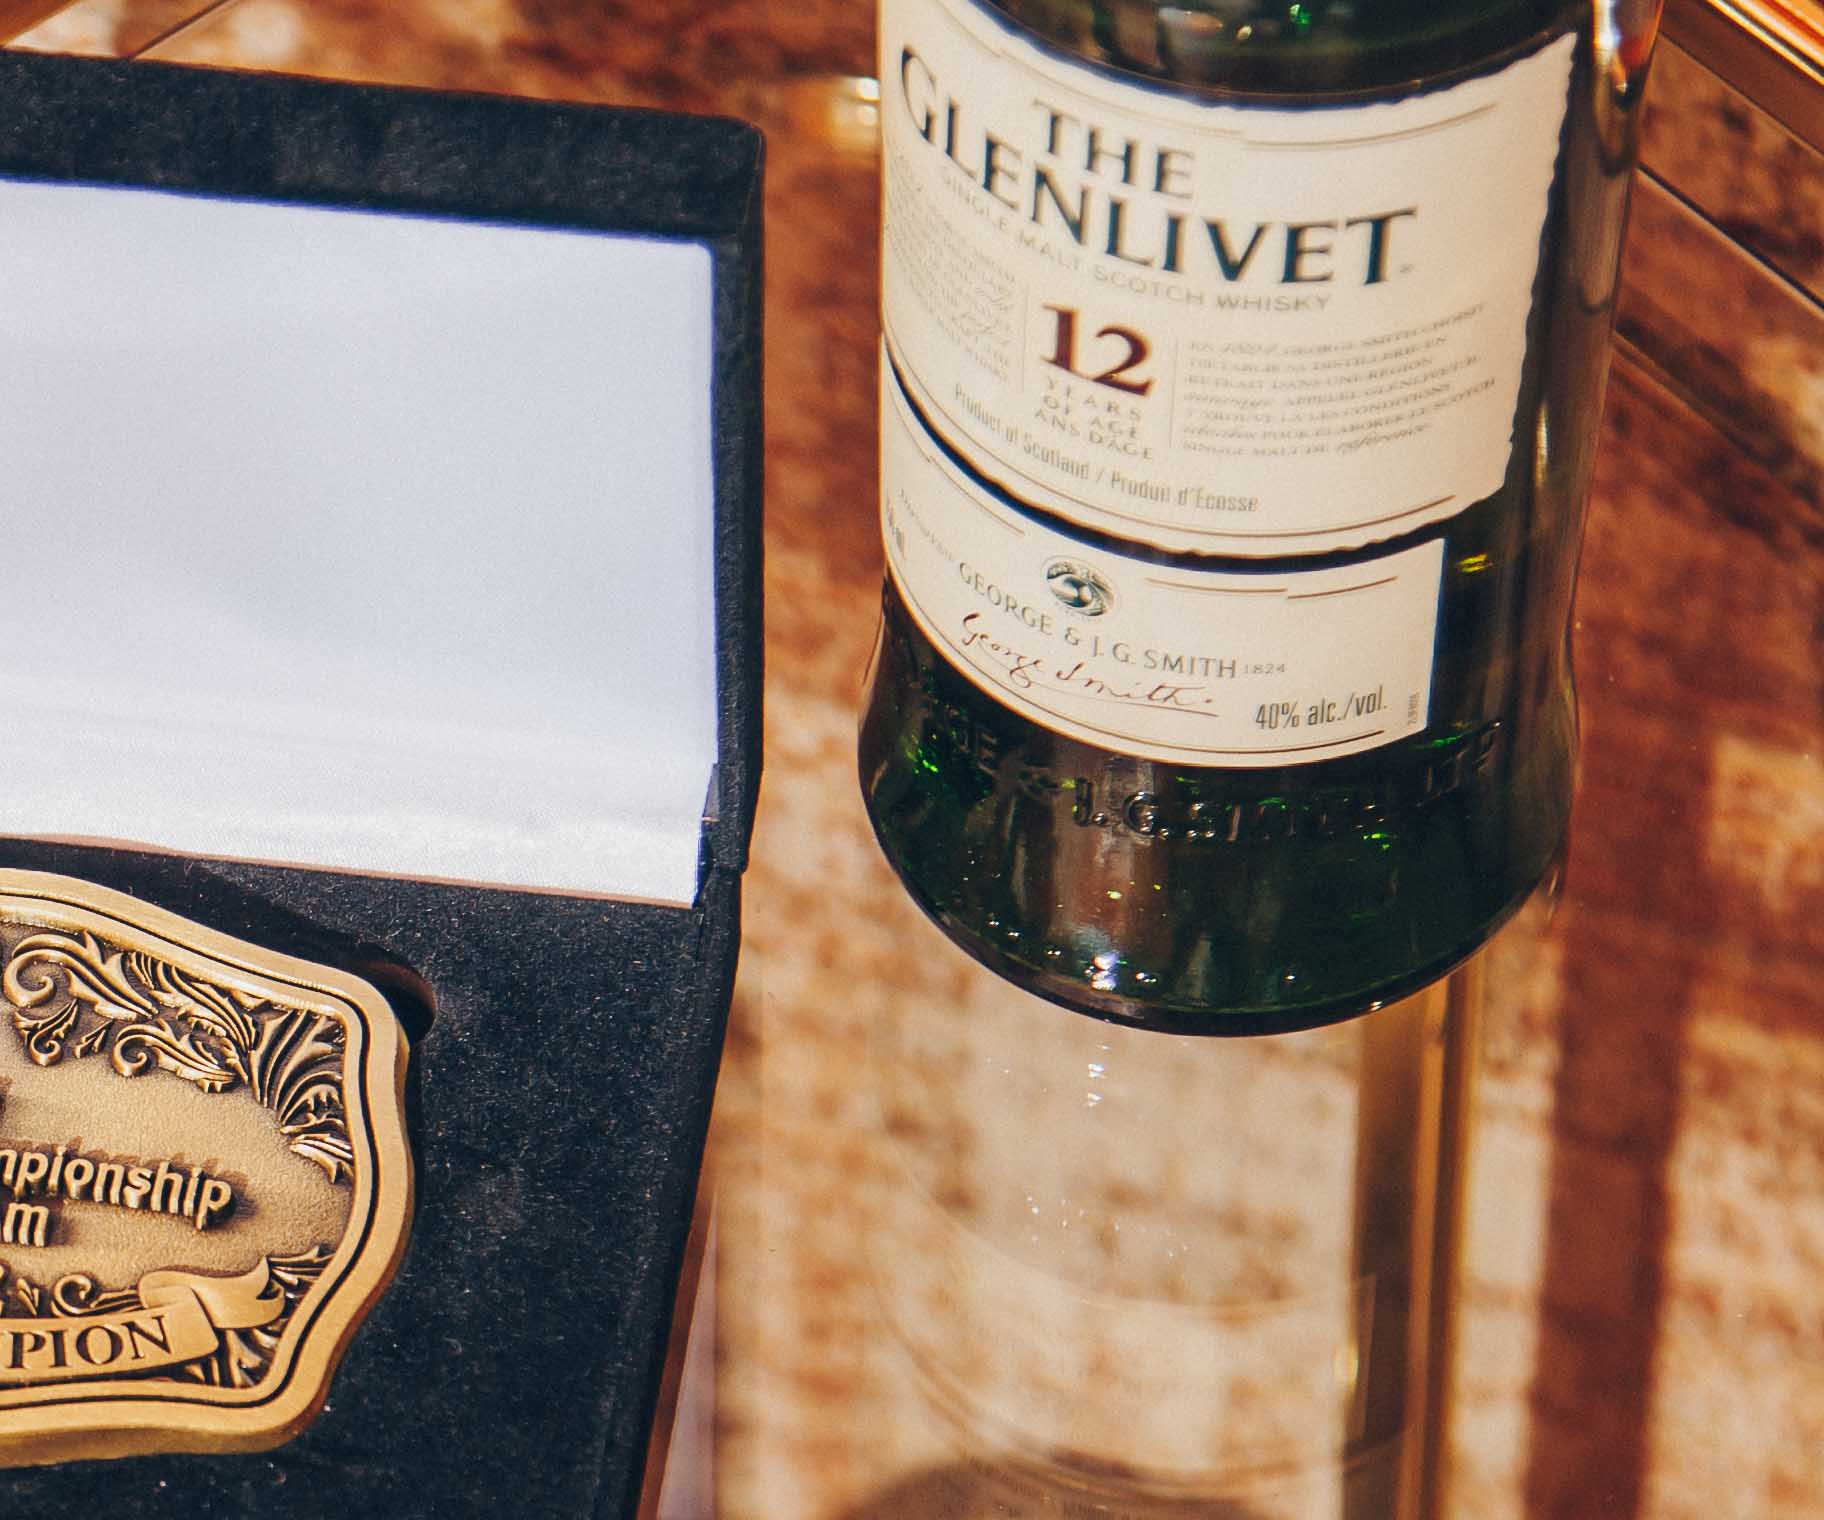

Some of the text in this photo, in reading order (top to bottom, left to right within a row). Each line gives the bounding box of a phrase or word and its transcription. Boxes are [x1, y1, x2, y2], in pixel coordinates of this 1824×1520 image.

[902, 46, 1417, 285] GLENLIVET
[1033, 98, 1194, 199] THE
[1092, 263, 1206, 307] SCOTCH
[1216, 293, 1333, 312] WHISKY
[1040, 302, 1157, 397] 12
[1034, 407, 1080, 437] ANS
[1047, 376, 1143, 421] YEARS
[1090, 416, 1139, 440] AGE
[955, 383, 1002, 433] Product
[1005, 423, 1019, 443] of
[1023, 432, 1090, 474] Scotland
[1095, 463, 1106, 482] /
[1111, 469, 1170, 503] Produit
[959, 561, 1054, 636] GEORGE
[1064, 627, 1080, 647] &
[1143, 648, 1236, 679] SMITH
[1244, 662, 1286, 675] 1824
[1255, 700, 1300, 730] 40%
[1307, 684, 1389, 727] alc./vol.
